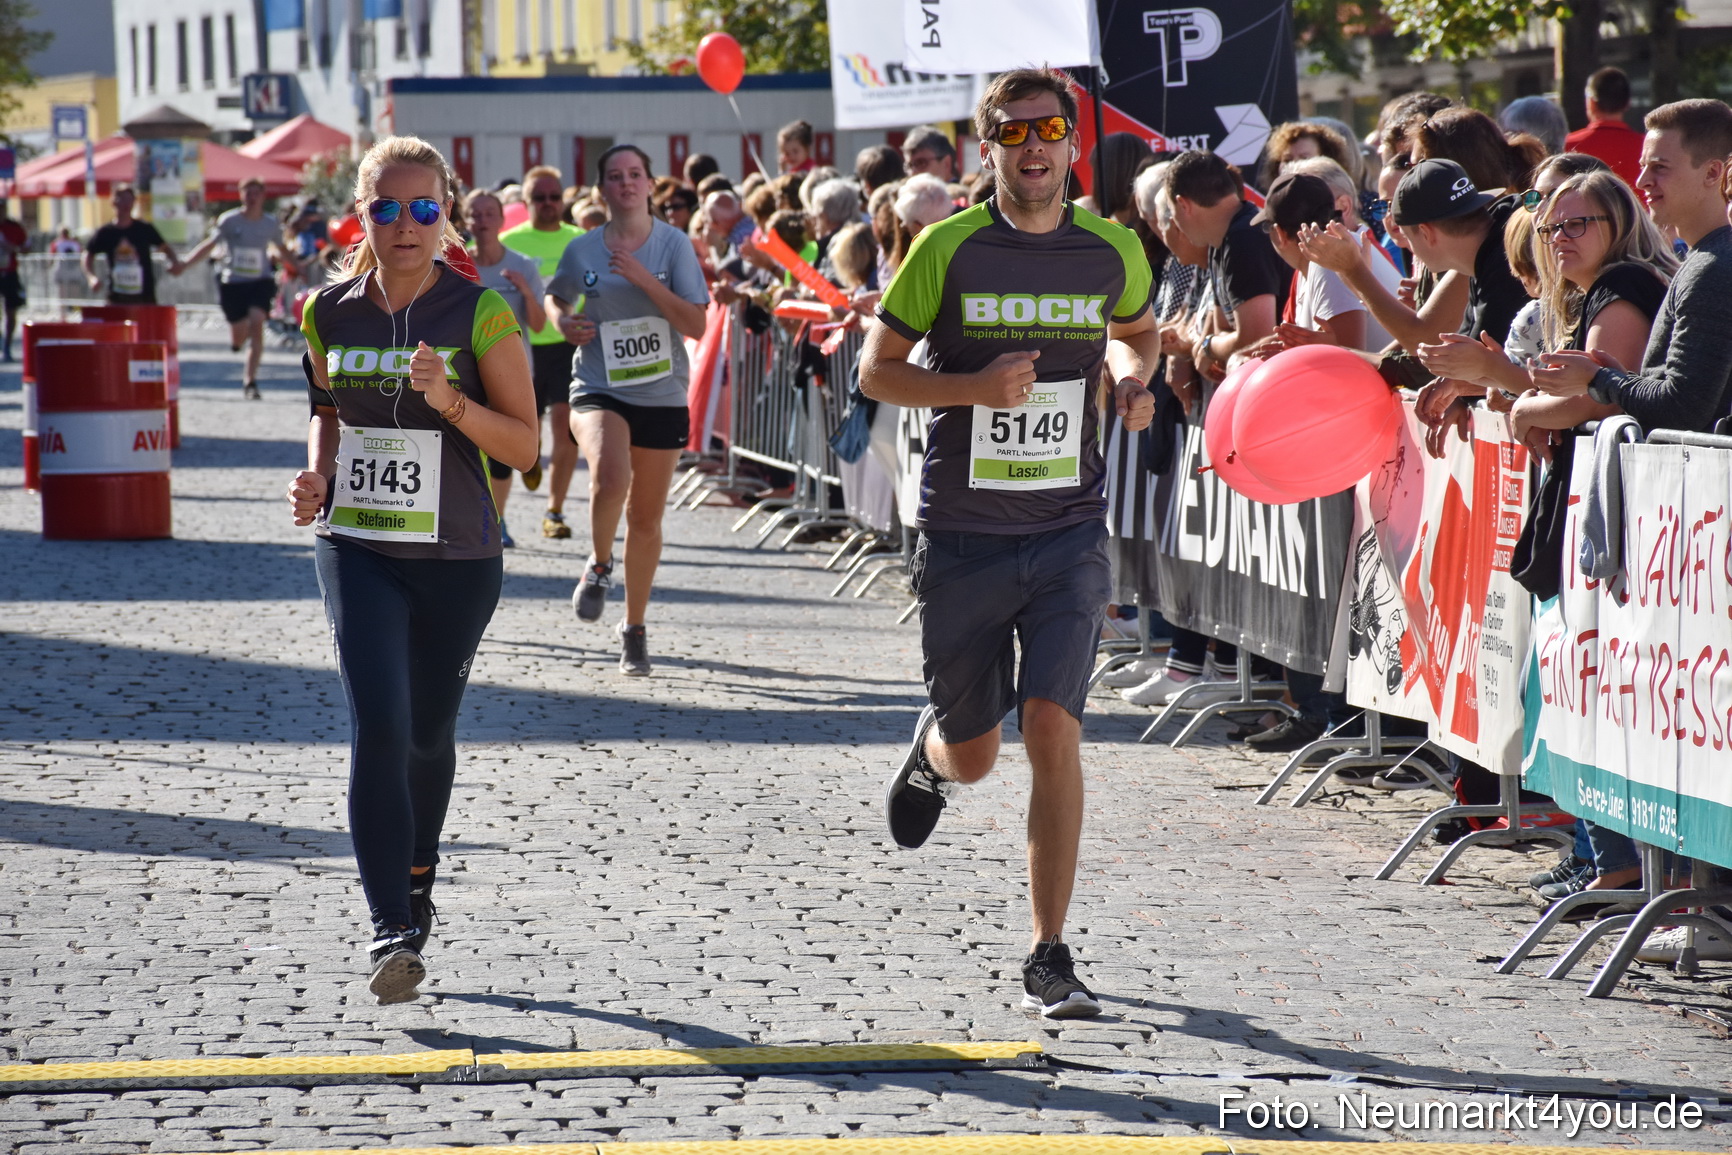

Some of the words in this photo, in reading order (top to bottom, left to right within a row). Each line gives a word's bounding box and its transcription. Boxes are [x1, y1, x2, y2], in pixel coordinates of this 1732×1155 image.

[1165, 134, 1210, 151] NEXT
[963, 294, 1106, 326] BOCK
[963, 327, 1008, 340] inspired
[1011, 328, 1025, 340] by
[1028, 330, 1061, 340] smart
[1064, 331, 1104, 342] concepts
[613, 333, 661, 359] 5006
[350, 379, 365, 389] by
[990, 411, 1069, 445] 5149
[363, 437, 406, 451] BOCK
[996, 448, 1021, 457] PARTL
[1022, 449, 1053, 457] Neumarkt
[349, 458, 421, 494] 5143
[1008, 464, 1049, 478] Laszlo
[353, 496, 371, 505] PARTL
[356, 512, 406, 528] Stefanie
[1649, 642, 1732, 752] BESS
